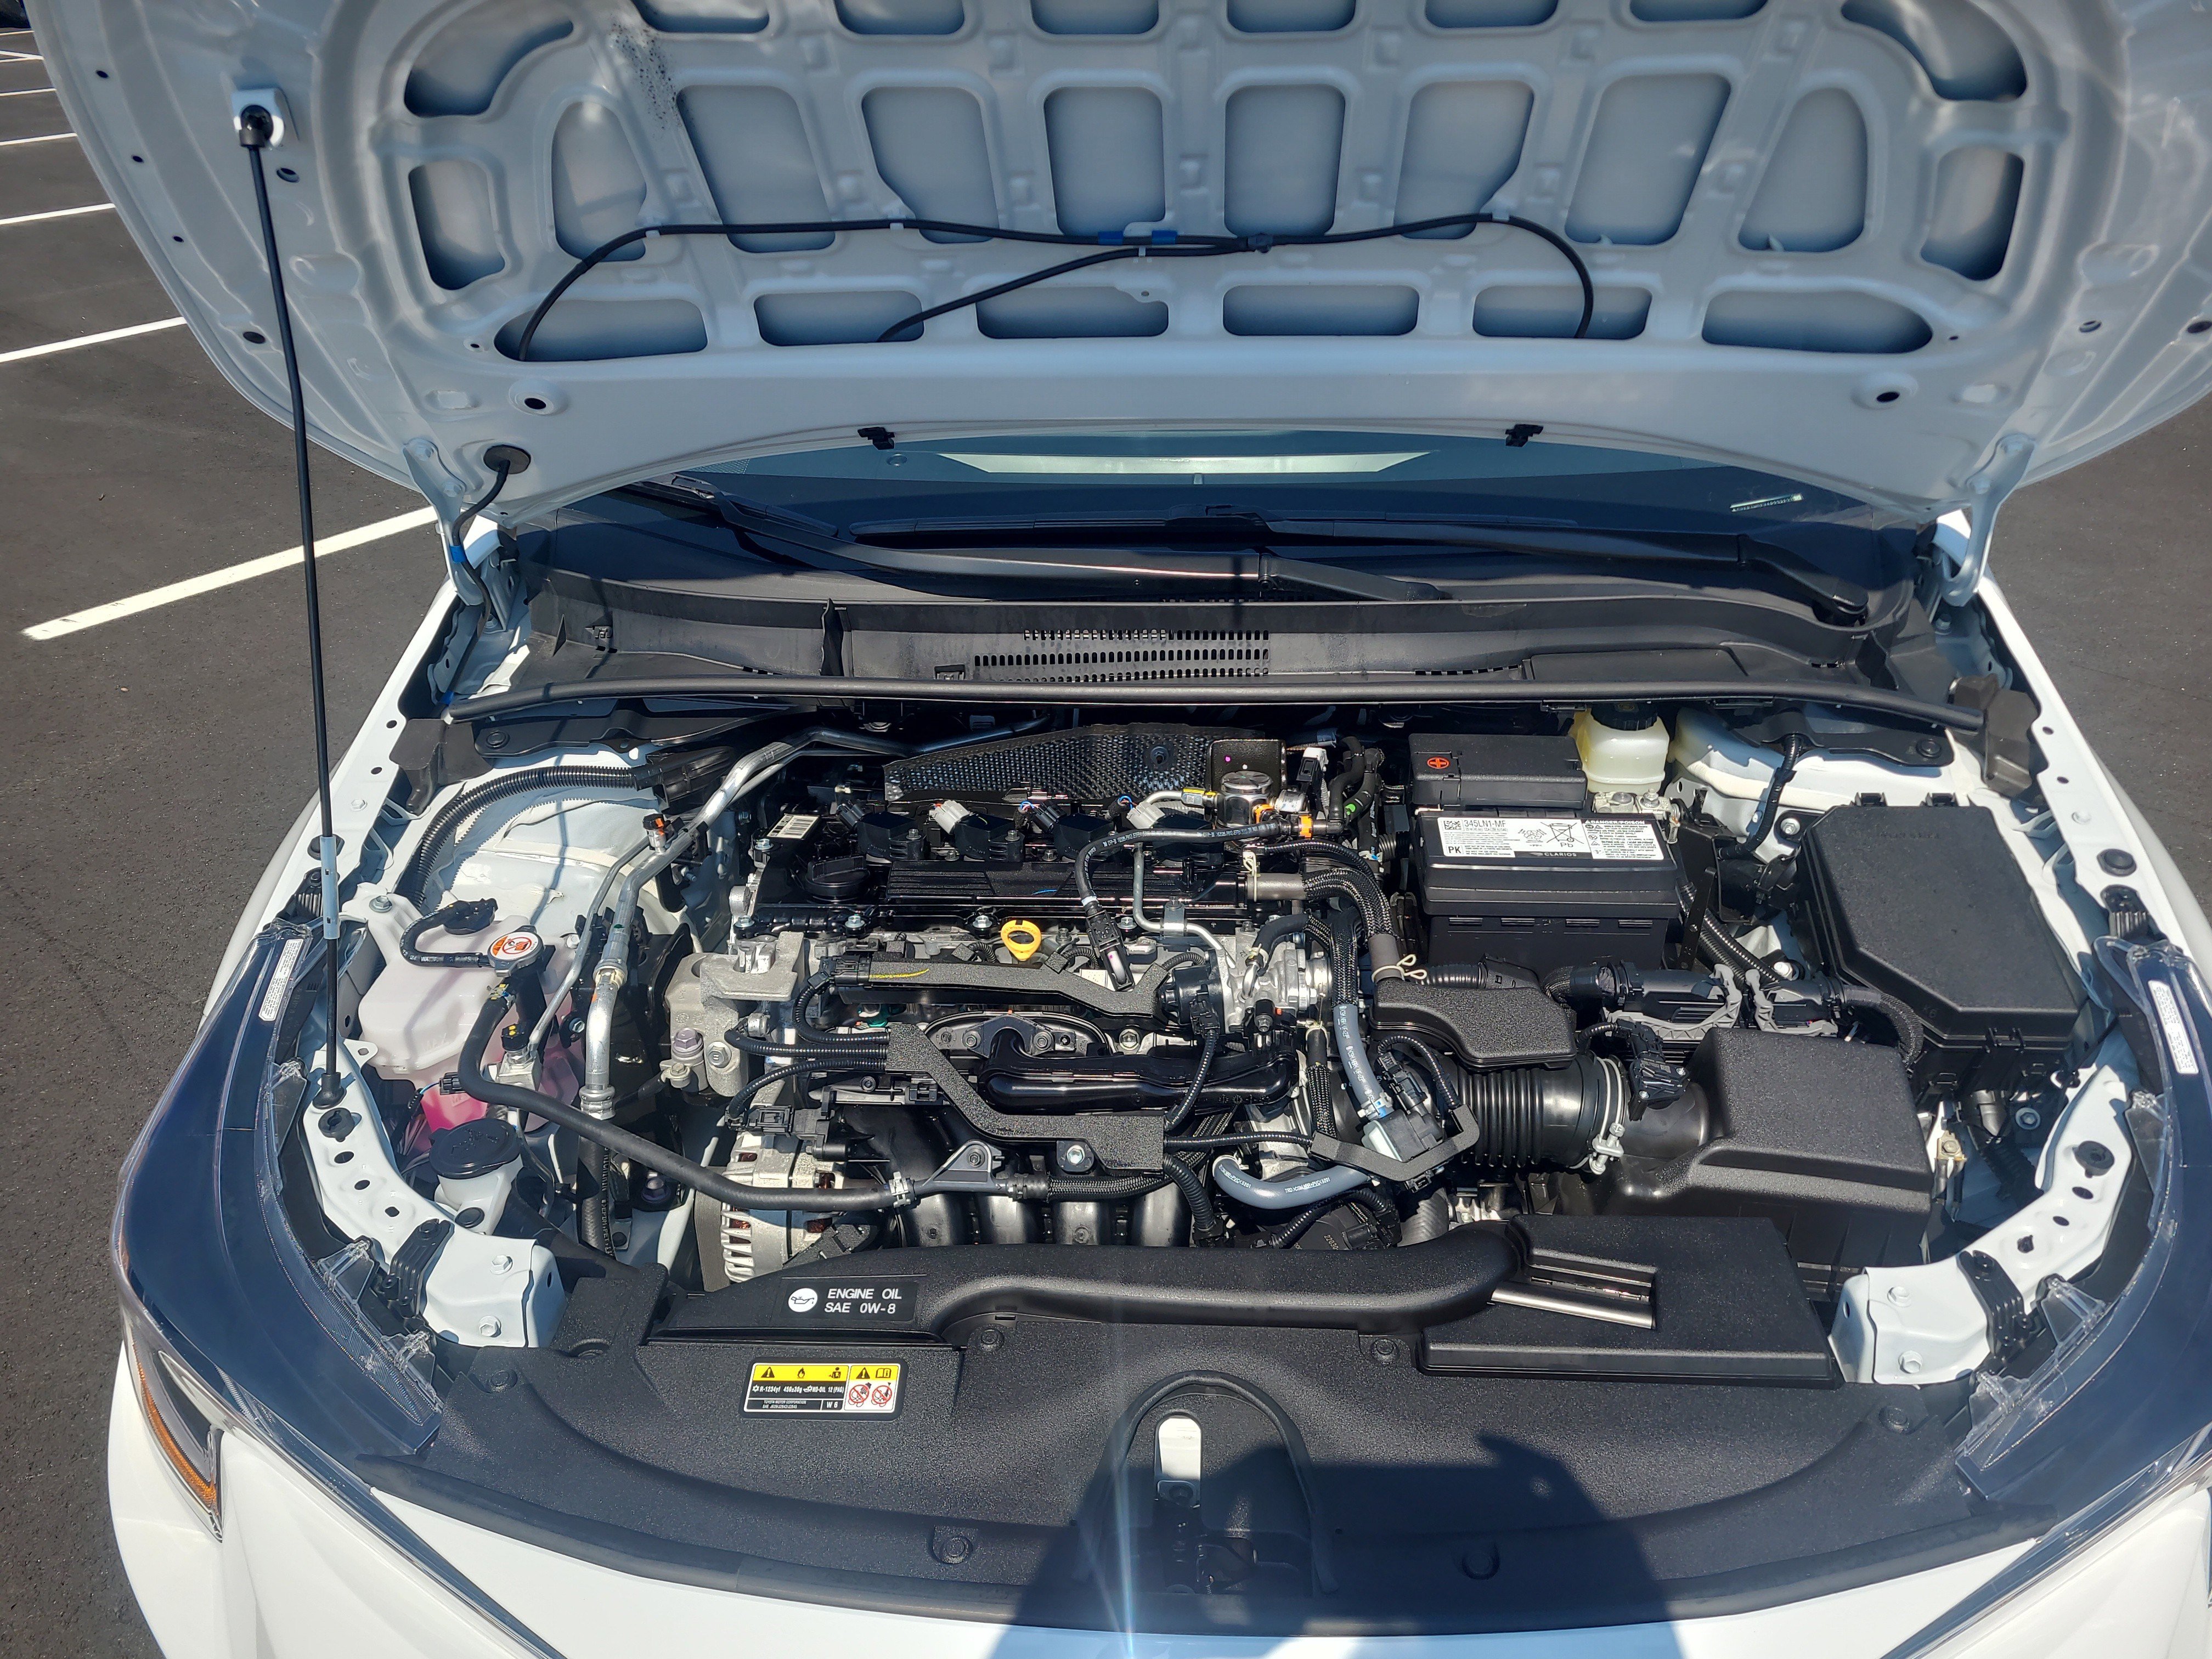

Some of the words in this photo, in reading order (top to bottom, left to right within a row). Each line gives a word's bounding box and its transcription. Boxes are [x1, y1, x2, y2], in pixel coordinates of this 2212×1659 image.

[827, 1288, 874, 1300] ENGINE
[882, 1288, 902, 1300] OIL
[824, 1302, 851, 1313] SAE
[860, 1302, 896, 1314] 0W-8
[759, 1386, 781, 1394] R-1234yf
